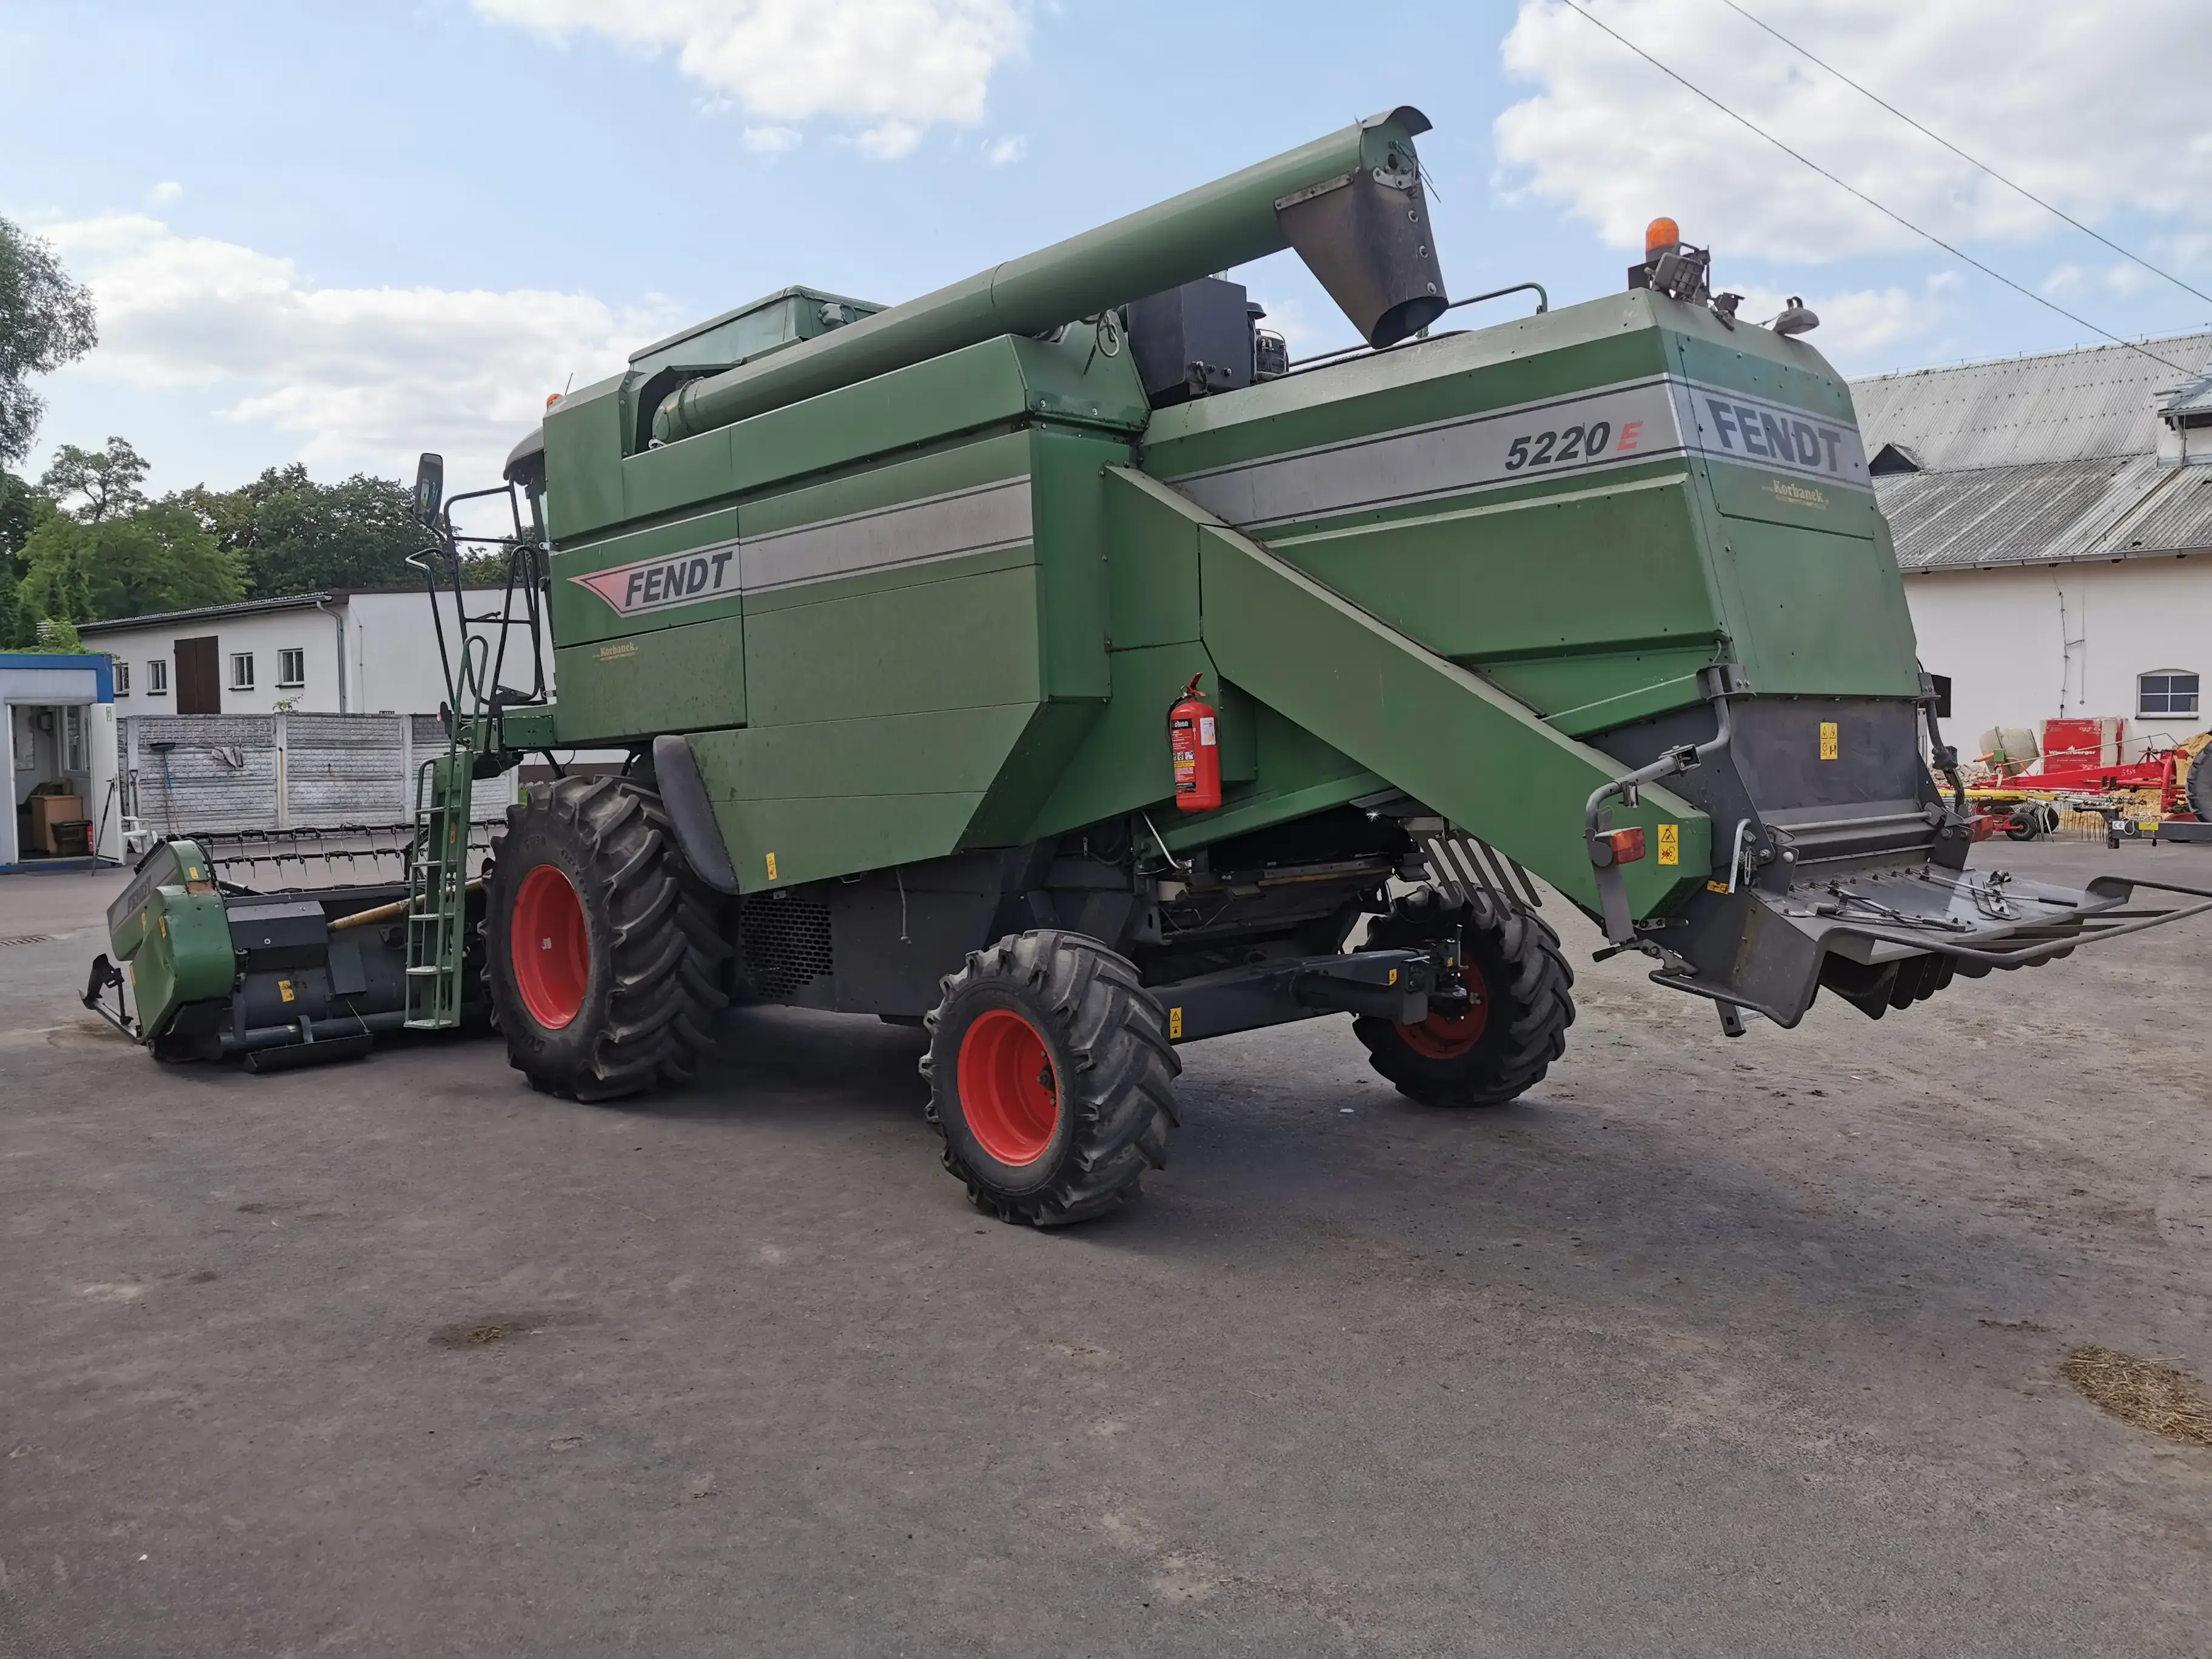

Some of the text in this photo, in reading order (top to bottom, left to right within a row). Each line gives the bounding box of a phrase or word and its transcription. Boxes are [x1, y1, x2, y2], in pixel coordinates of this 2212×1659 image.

[1505, 420, 1643, 471] 5220 E
[1706, 398, 1842, 472] FENDT
[1772, 479, 1825, 503] Korbanek
[625, 551, 733, 607] FENDT
[600, 642, 635, 657] Korbanek
